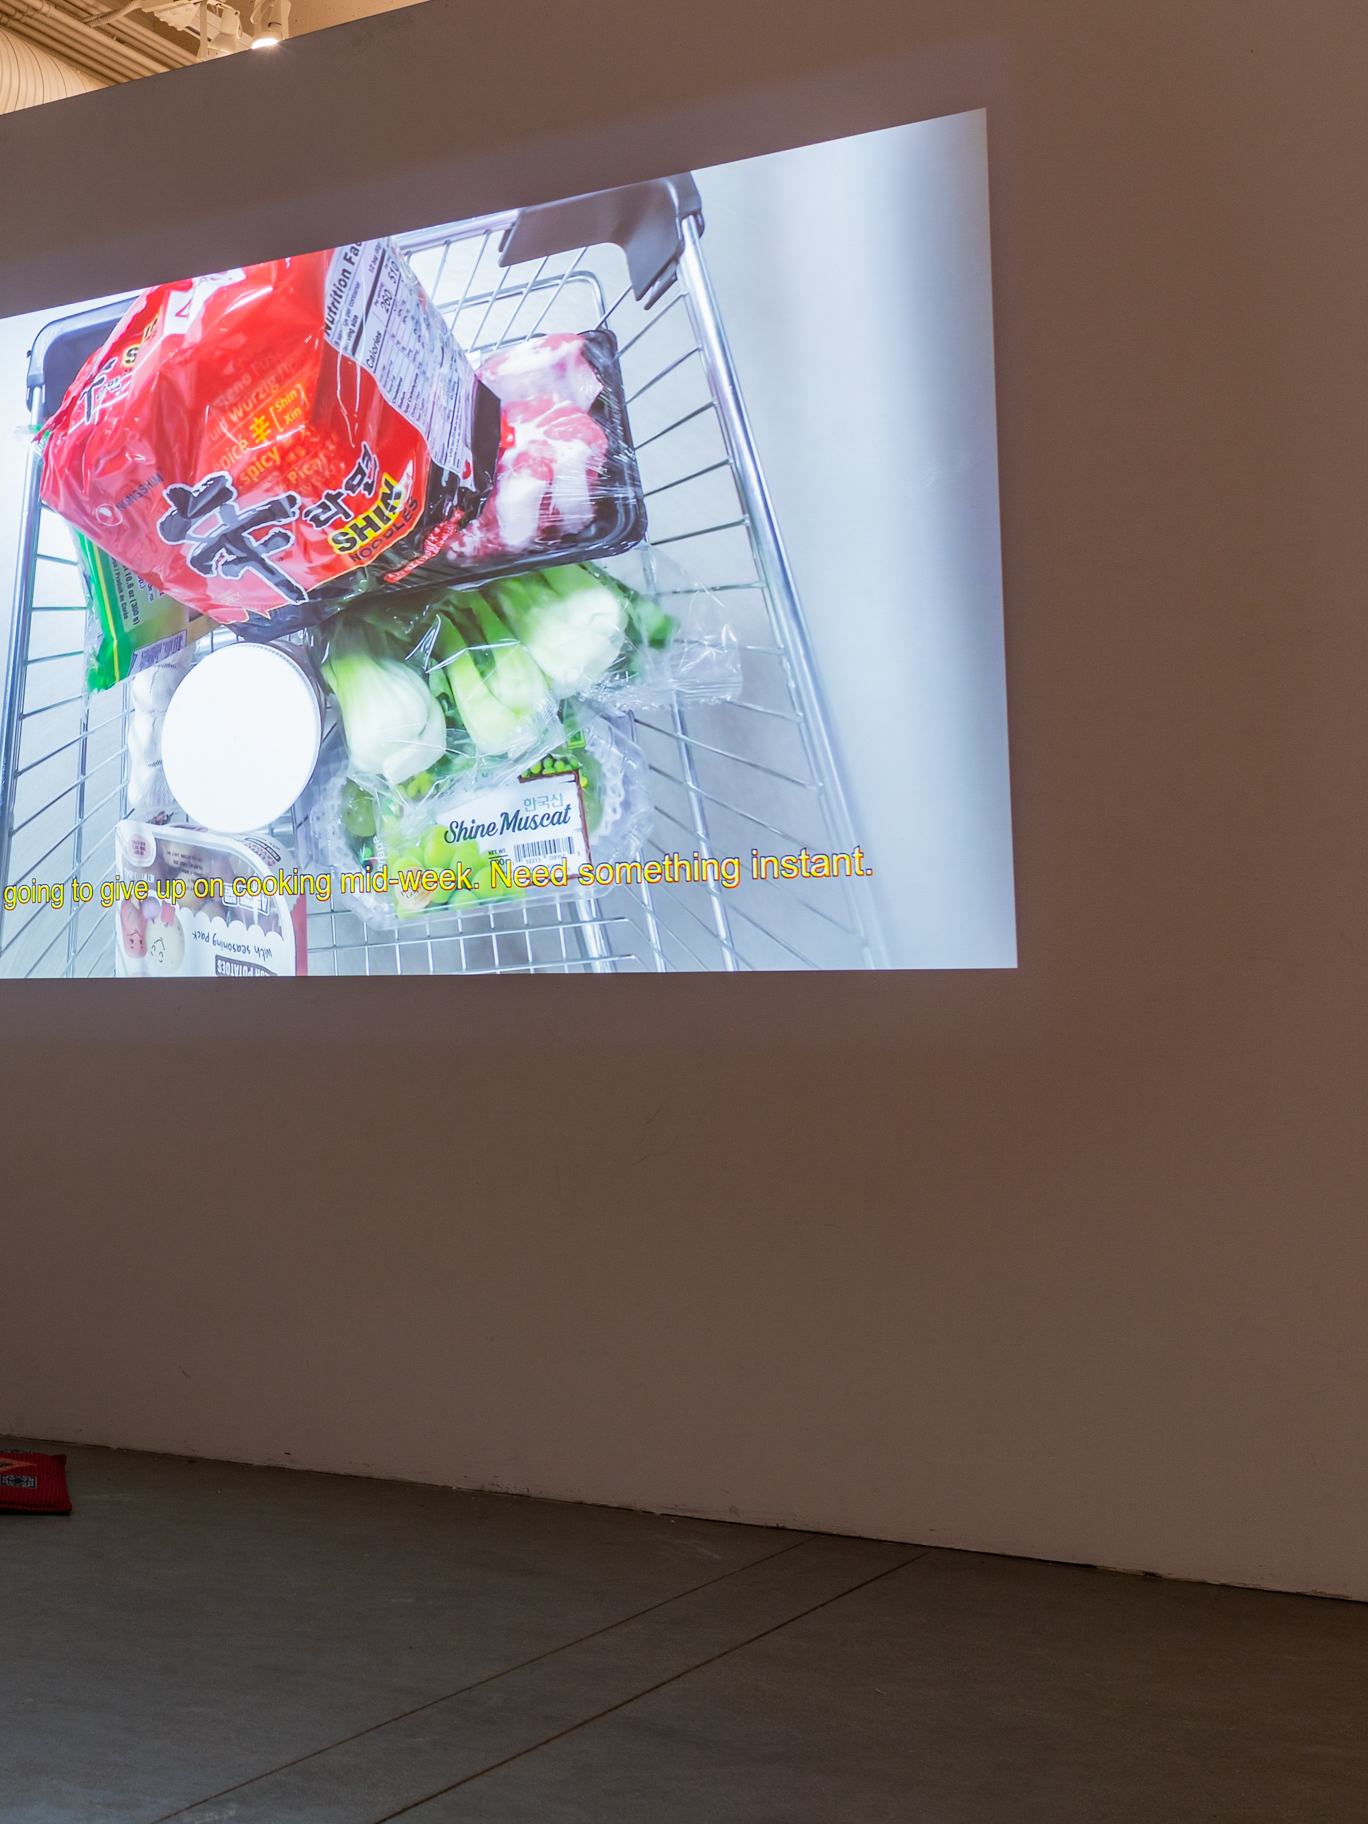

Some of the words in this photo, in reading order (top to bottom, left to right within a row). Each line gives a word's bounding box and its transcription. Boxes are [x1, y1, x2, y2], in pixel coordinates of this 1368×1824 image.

[324, 267, 352, 337] Nutrition
[366, 330, 382, 369] Calories
[380, 288, 393, 314] 260
[388, 260, 400, 284] 510
[239, 446, 281, 486] spicy
[117, 473, 164, 511] NONGSHIM
[331, 476, 403, 553] SHIN
[349, 497, 418, 562] NOODLES
[125, 572, 135, 590] 10.6
[443, 819, 498, 844] Shine
[498, 803, 572, 836] Muscat
[4, 878, 64, 911] going
[71, 877, 93, 902] to
[100, 876, 148, 907] give
[157, 876, 186, 904] up
[194, 878, 224, 898] on
[232, 868, 331, 902] cooking
[341, 861, 481, 894] mid-week.
[490, 857, 568, 889] Need
[578, 851, 741, 889] something
[751, 845, 874, 881] instant.
[212, 932, 251, 954] seasoning
[254, 945, 273, 962] with
